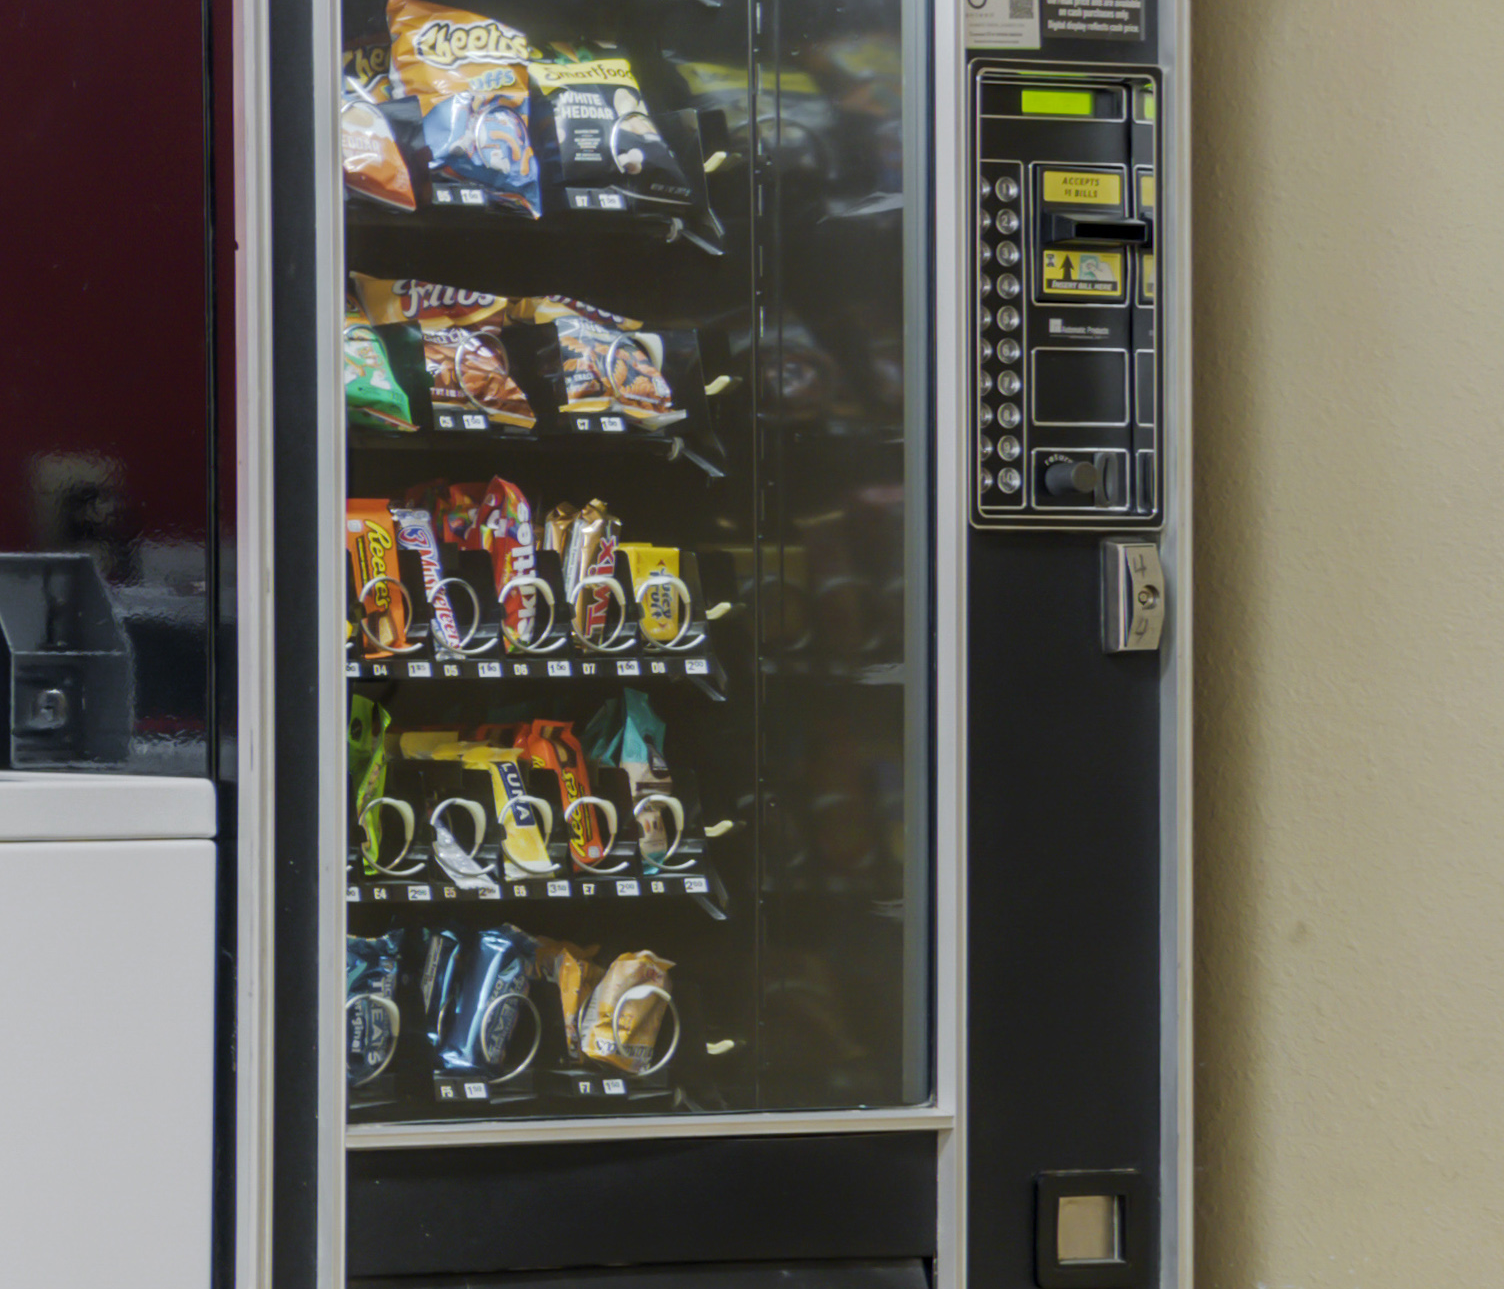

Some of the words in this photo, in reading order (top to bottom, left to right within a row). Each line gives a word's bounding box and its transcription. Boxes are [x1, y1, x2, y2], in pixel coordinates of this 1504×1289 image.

[416, 22, 528, 66] Cheetos
[544, 63, 634, 82] Smartfood
[559, 90, 602, 107] WHITE
[554, 105, 615, 120] CHEDDAR
[1062, 176, 1100, 187] ACCEPTS
[1074, 189, 1098, 198] BILLS
[1051, 280, 1077, 289] INSERT
[1077, 282, 1092, 290] BILL
[1094, 282, 1113, 291] HERE
[399, 526, 427, 550] 3
[365, 519, 393, 609] Reese's
[587, 535, 616, 637] Twix
[373, 664, 388, 676] D4
[444, 664, 458, 676] D5
[514, 664, 528, 676] D6
[583, 664, 596, 675] D7
[500, 761, 532, 821] LUNA
[441, 1086, 454, 1098] F5
[579, 1082, 592, 1093] F7
